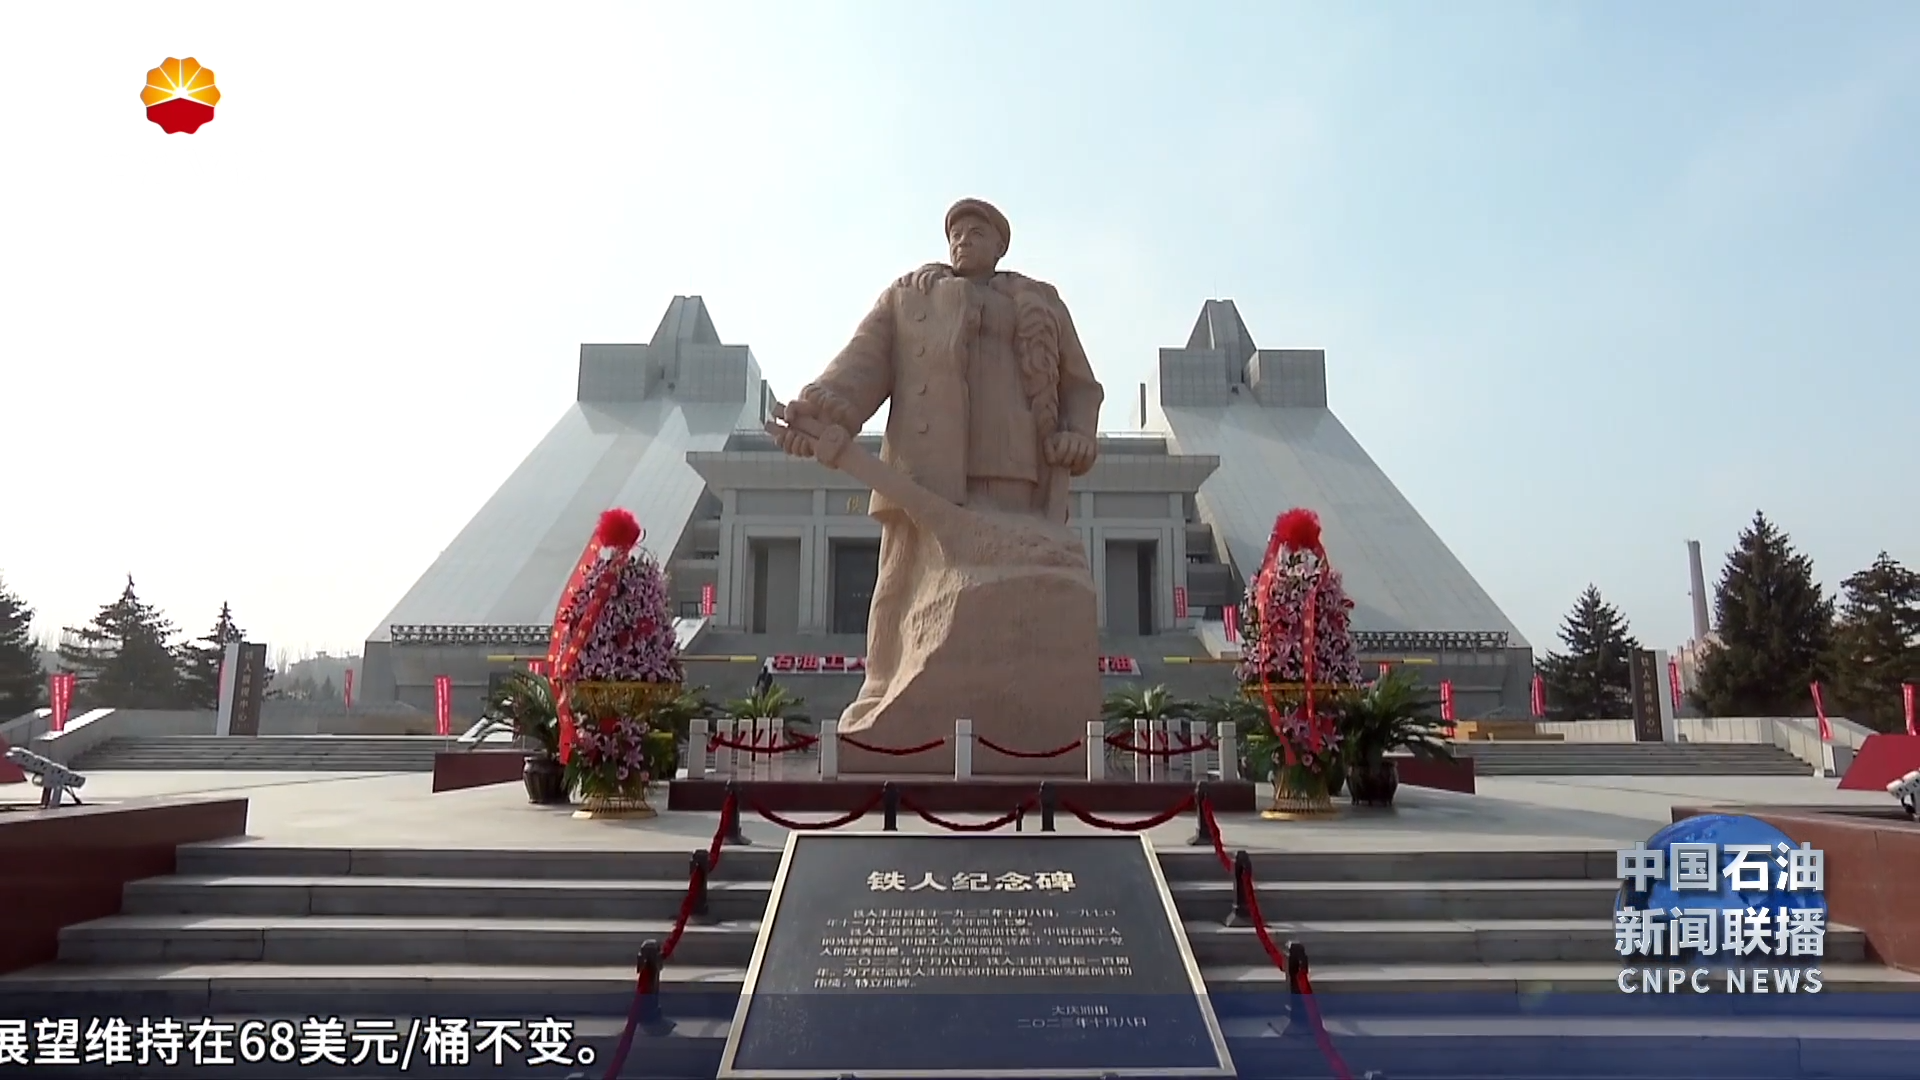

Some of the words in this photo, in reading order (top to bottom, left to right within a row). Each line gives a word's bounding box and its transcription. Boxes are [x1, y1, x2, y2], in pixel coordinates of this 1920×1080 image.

[867, 870, 1077, 893] 铁人纪念碑
